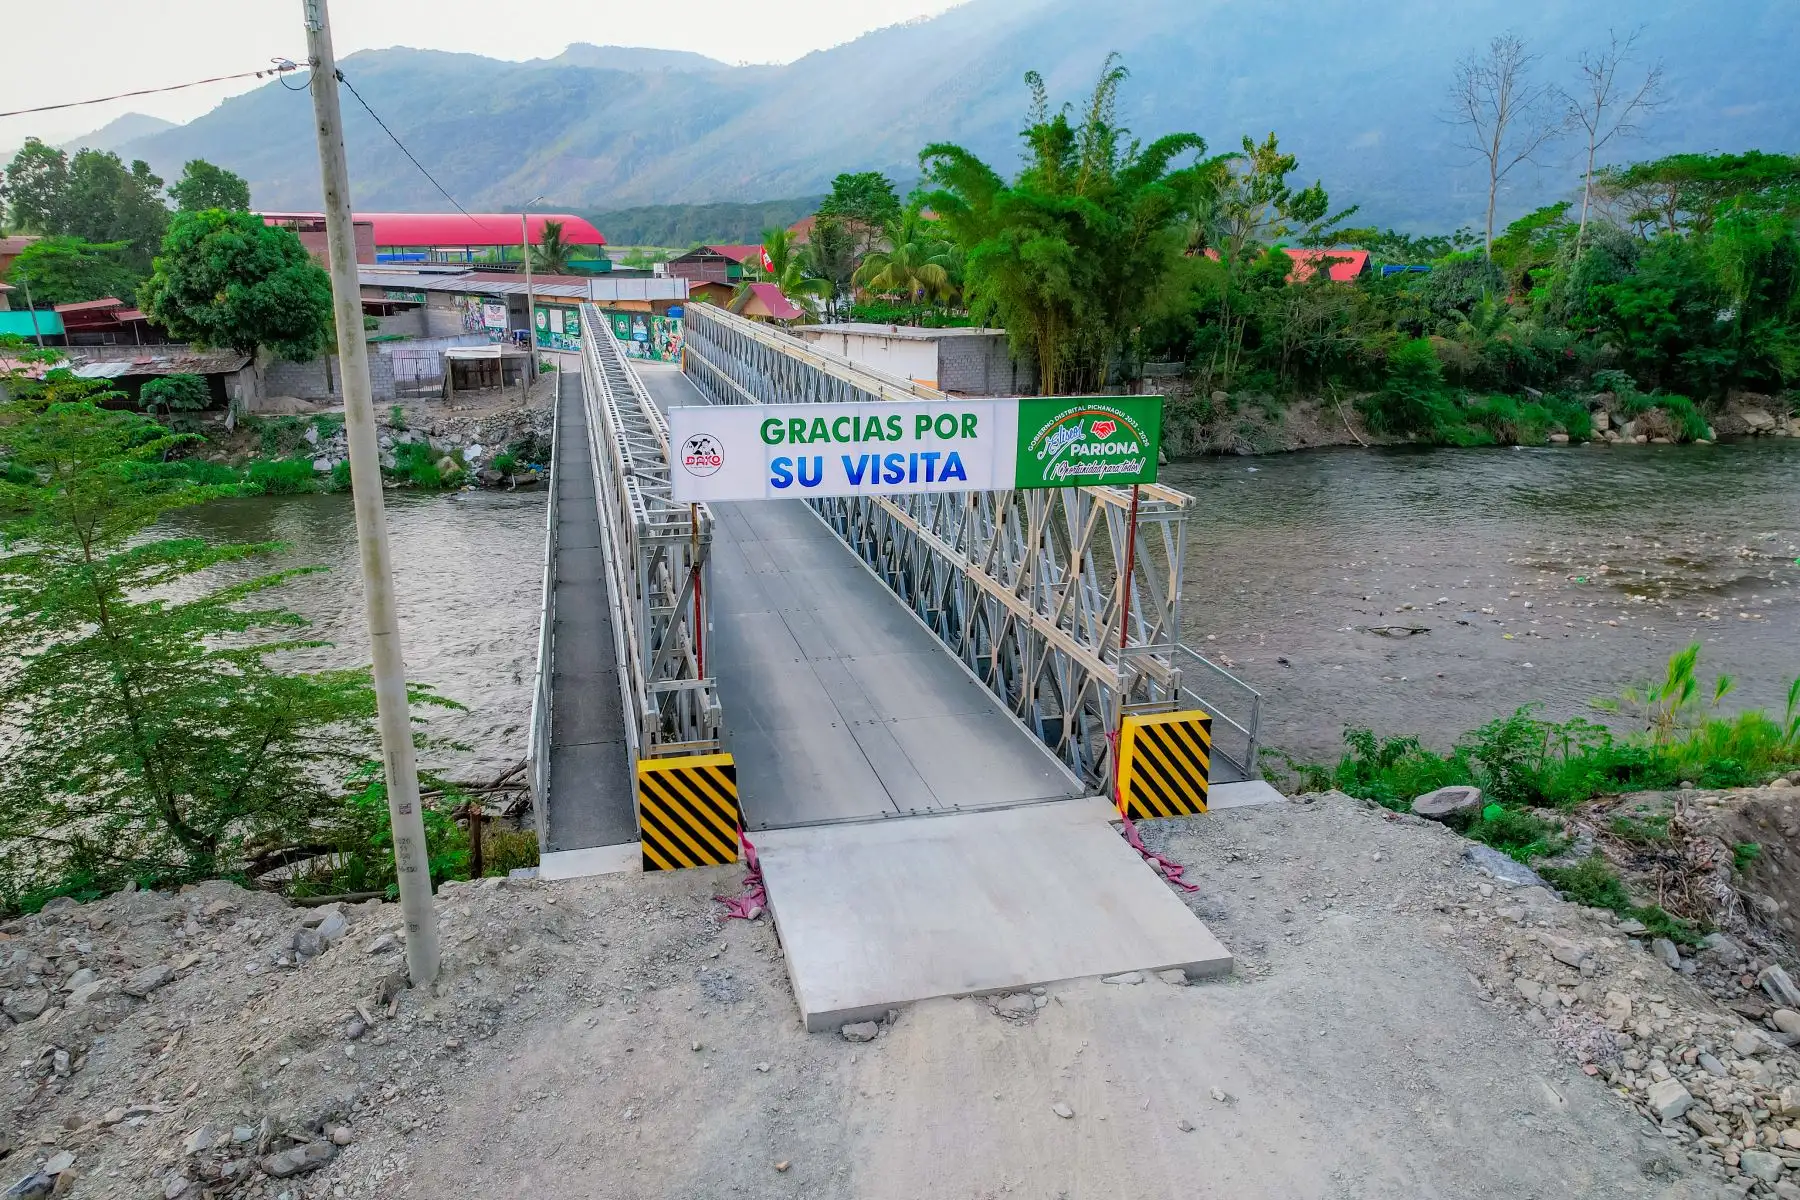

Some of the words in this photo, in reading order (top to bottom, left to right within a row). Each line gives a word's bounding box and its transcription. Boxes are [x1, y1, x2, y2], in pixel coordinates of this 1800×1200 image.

[760, 415, 903, 445] GRACIAS
[915, 413, 978, 440] POR
[1028, 419, 1055, 451] GOBIERNO
[1054, 405, 1086, 421] DISTRITAL
[1087, 404, 1126, 418] PICHANAQUI
[685, 455, 721, 466] DAKO
[1070, 441, 1140, 457] PARIONA
[770, 455, 823, 489] SU
[841, 451, 968, 486] VISITA
